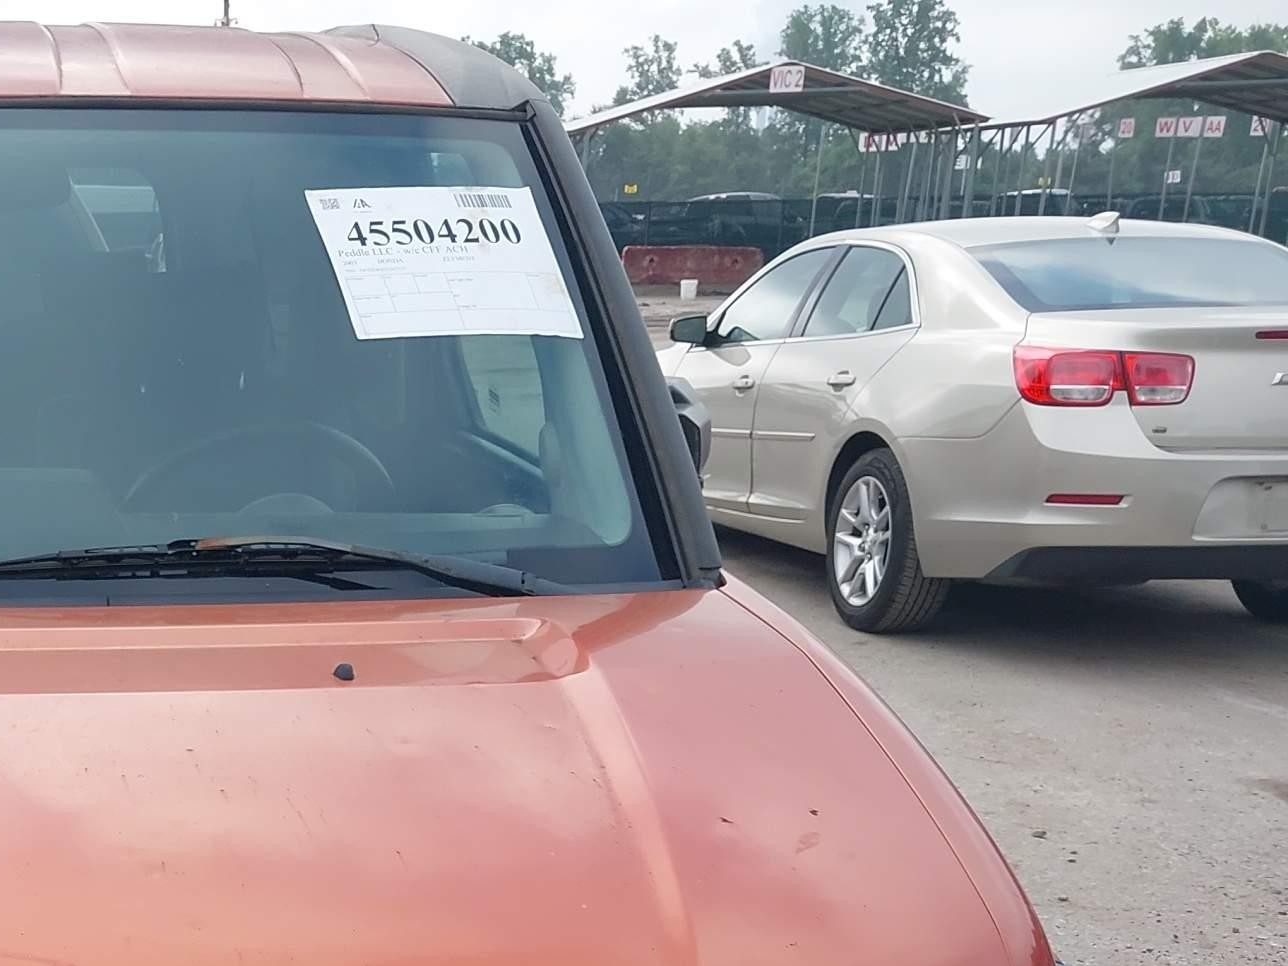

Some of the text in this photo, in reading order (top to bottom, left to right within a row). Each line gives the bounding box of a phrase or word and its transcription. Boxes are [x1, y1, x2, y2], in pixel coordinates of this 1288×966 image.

[772, 69, 803, 89] VIC 2
[1158, 118, 1173, 133] W
[1182, 119, 1193, 132] V
[1207, 120, 1221, 133] AA
[347, 218, 521, 247] 45504200
[337, 248, 370, 257] Peddle
[371, 247, 393, 256] LLC
